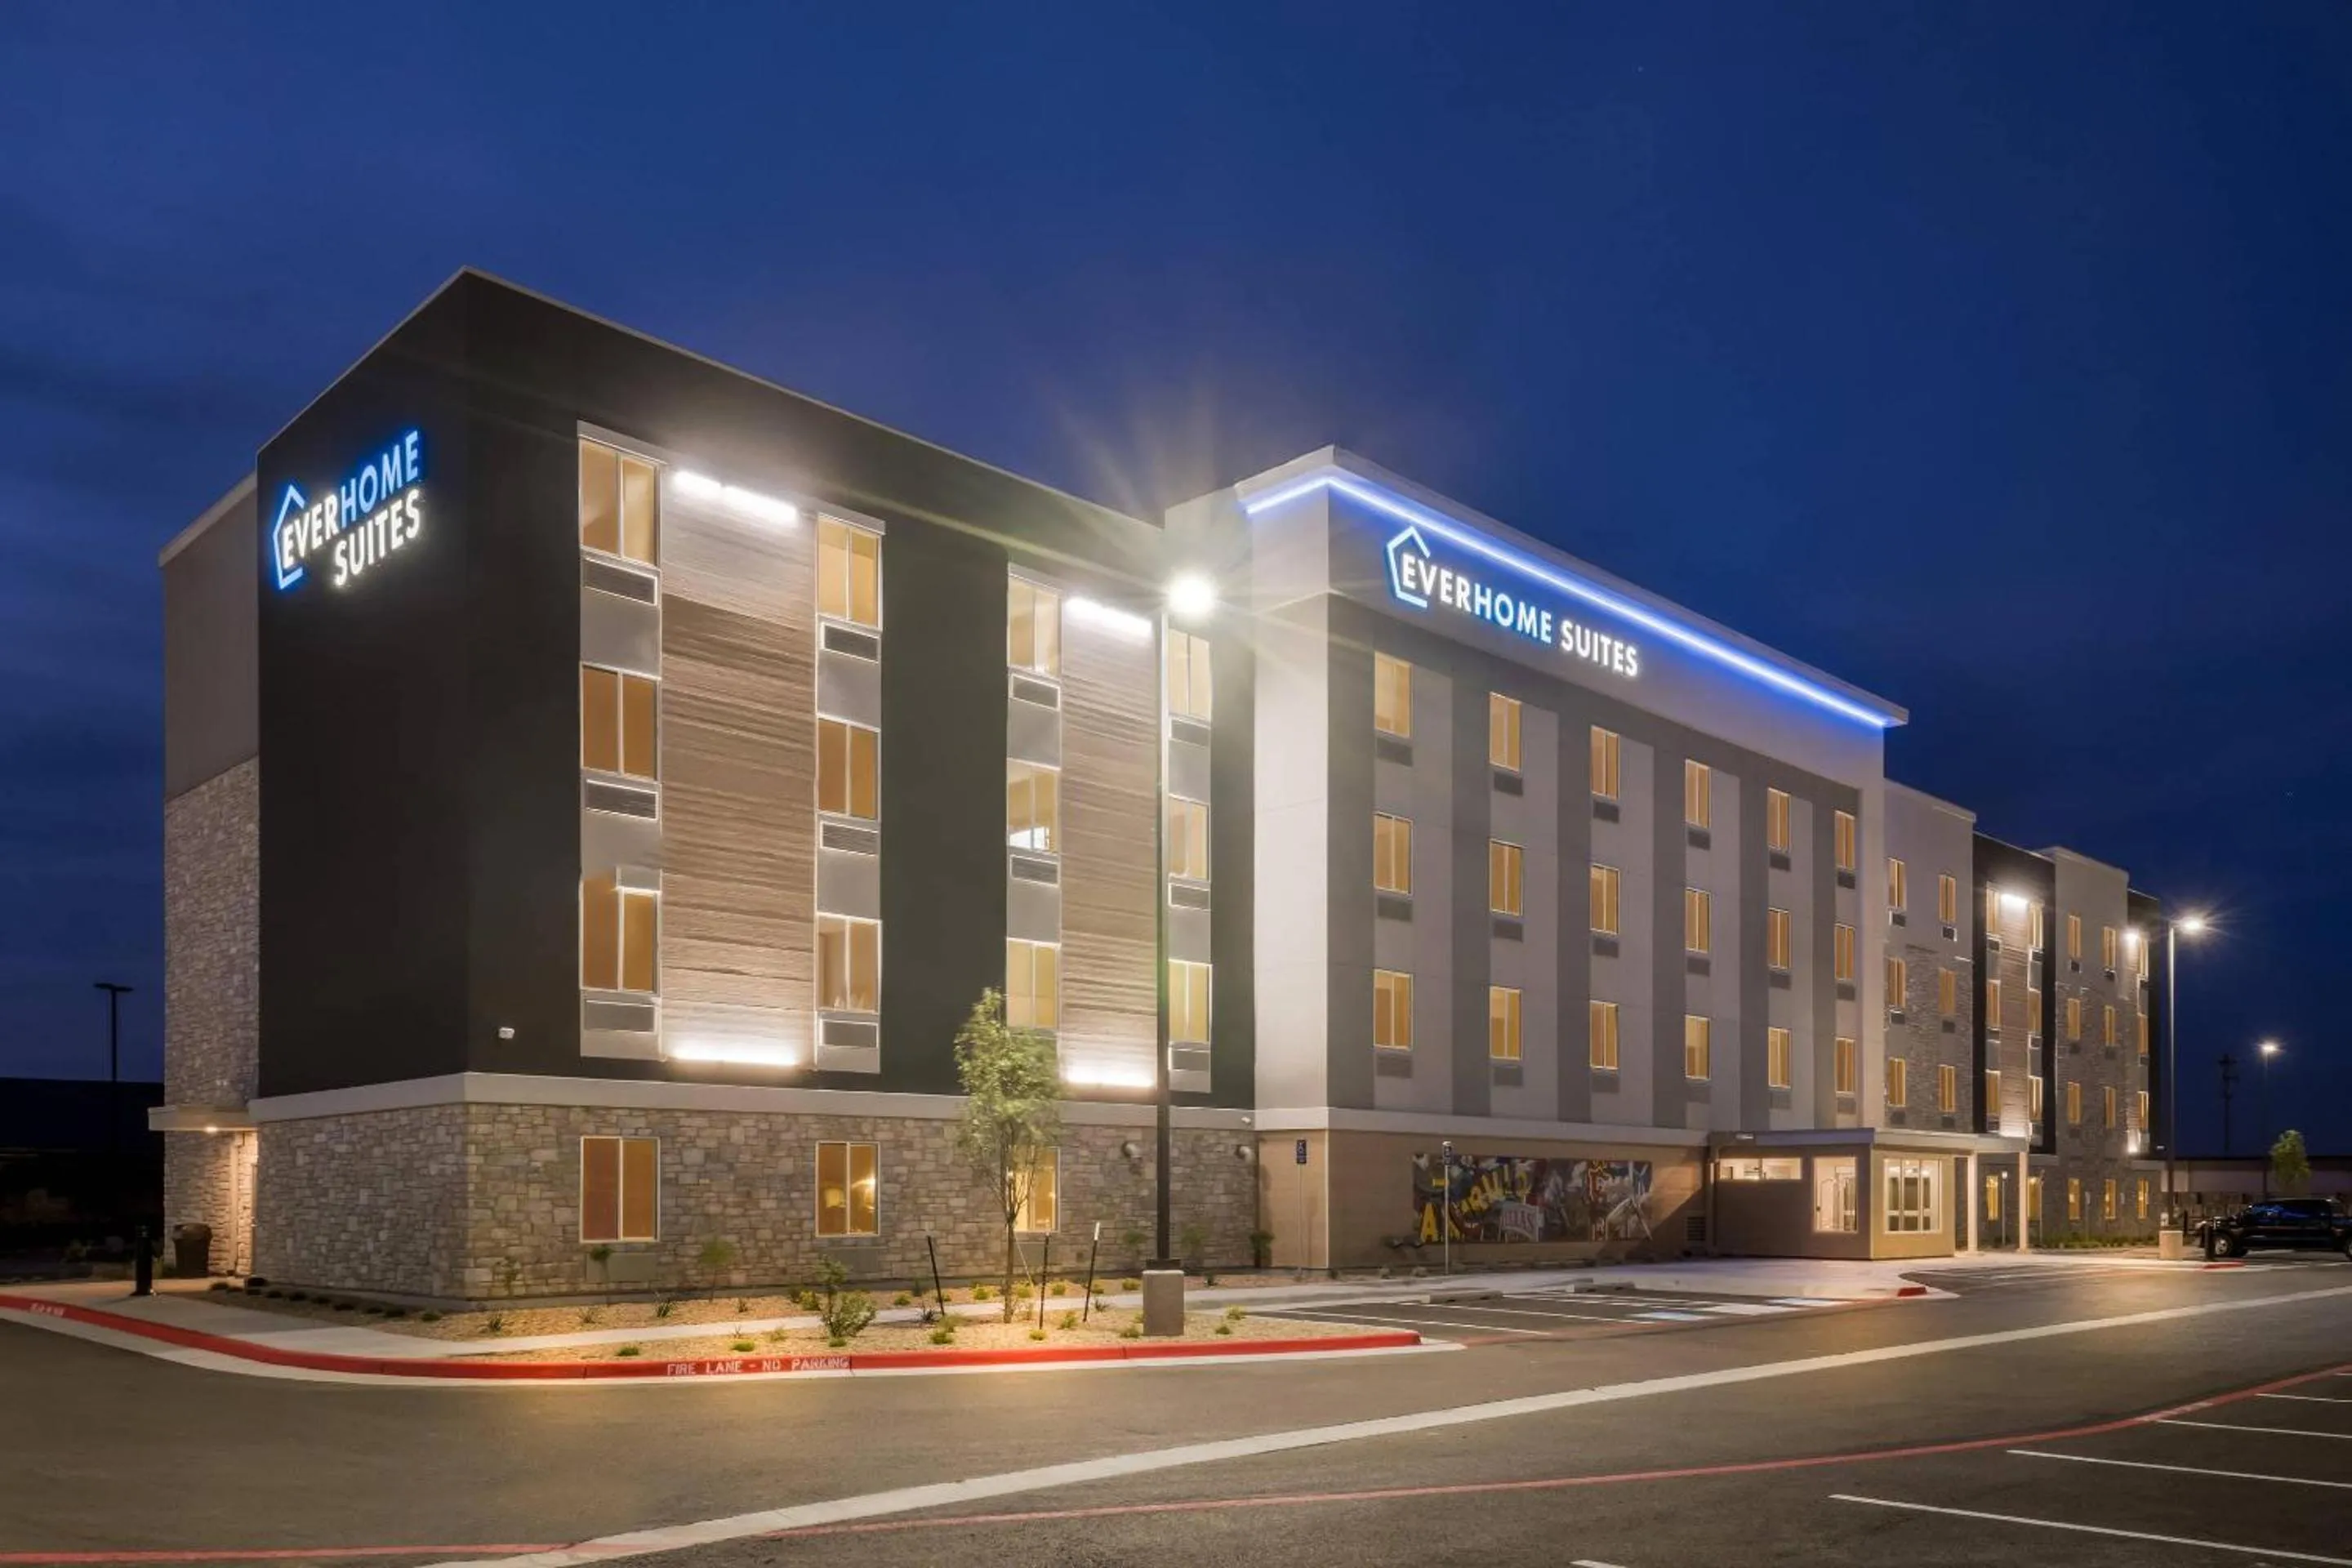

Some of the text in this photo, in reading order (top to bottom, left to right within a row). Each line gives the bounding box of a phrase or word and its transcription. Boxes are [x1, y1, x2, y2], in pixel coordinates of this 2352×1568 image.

[282, 430, 418, 569] EVERHOME
[334, 488, 420, 586] SUITES
[1401, 552, 1638, 677] EVERHOME SUITES
[666, 1363, 696, 1376] FIRE
[706, 1361, 744, 1374] LANE
[762, 1361, 781, 1372] NO
[791, 1356, 849, 1371] PARKING
